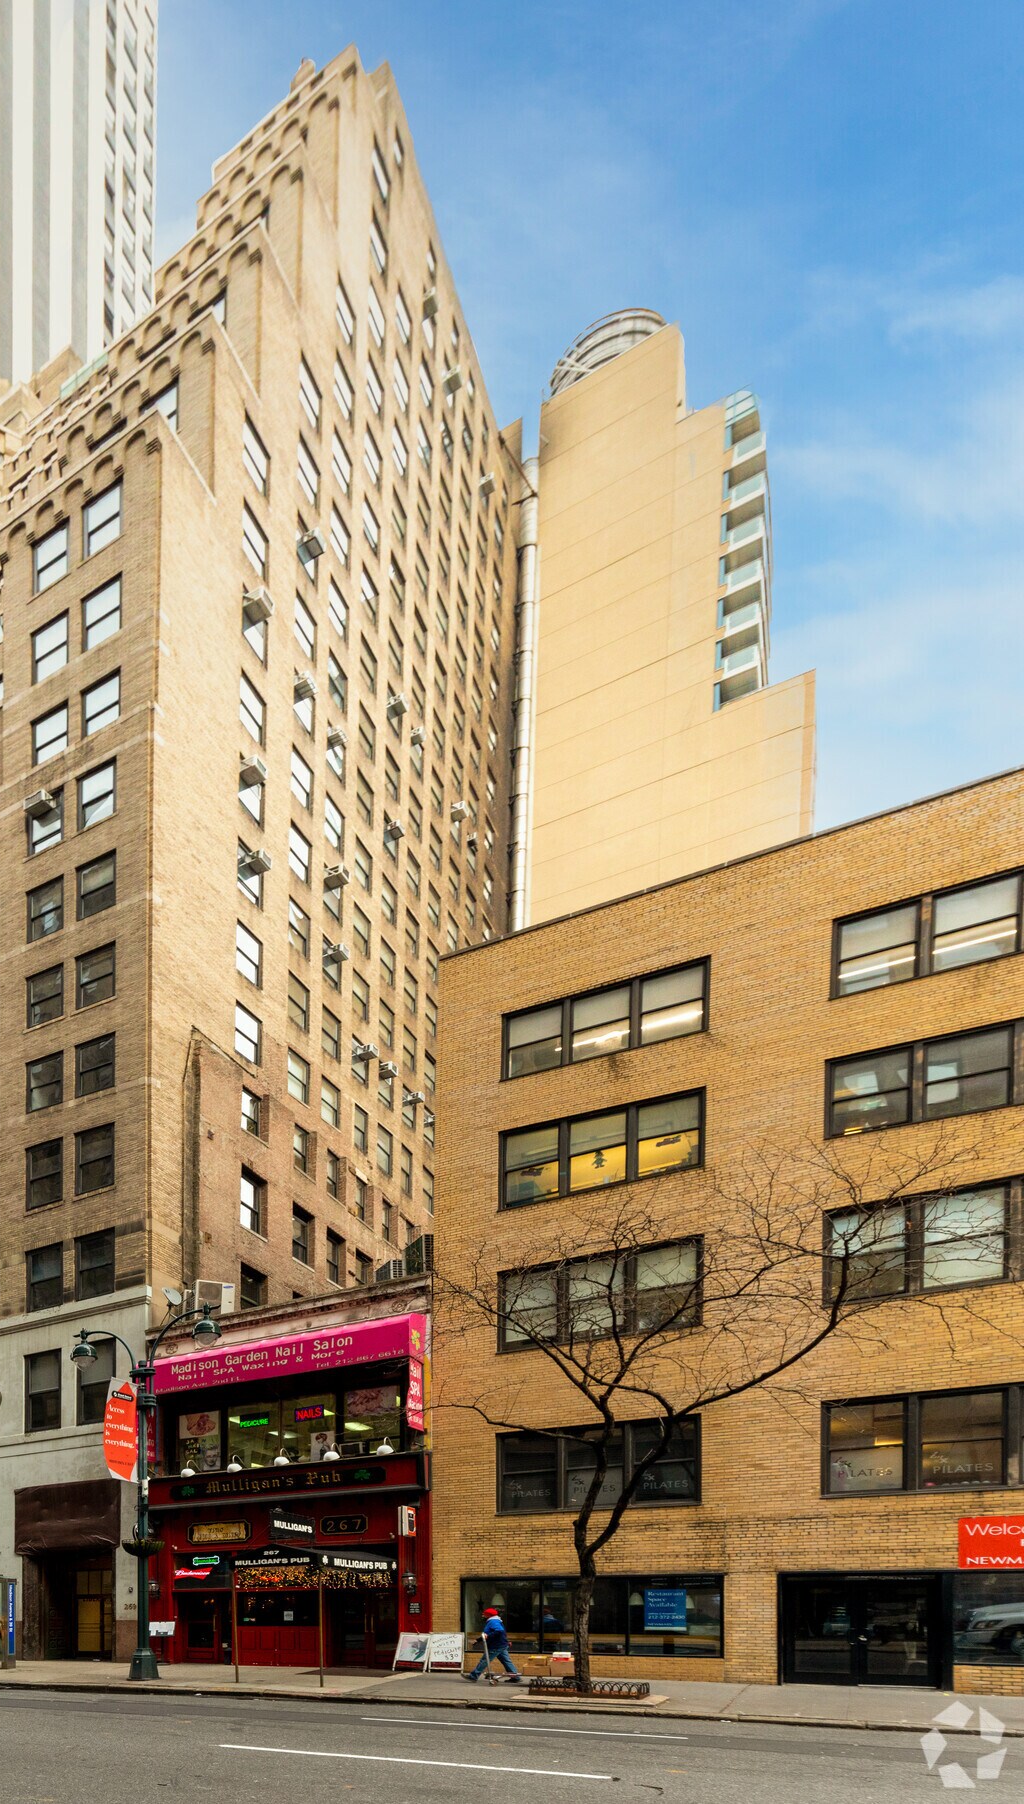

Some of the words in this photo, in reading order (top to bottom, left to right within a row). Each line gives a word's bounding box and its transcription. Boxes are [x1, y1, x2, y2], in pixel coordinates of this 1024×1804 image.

[171, 1359, 218, 1375] Madison
[225, 1350, 268, 1366] Garden
[275, 1343, 304, 1357] Nail
[313, 1336, 353, 1351] Salon
[177, 1371, 204, 1381] Nail
[213, 1367, 235, 1376] SPA
[241, 1359, 288, 1371] Waxing
[311, 1349, 344, 1360] More
[108, 1404, 125, 1414] Access
[297, 1408, 322, 1420] NAILS
[105, 1422, 134, 1433] everything
[240, 1418, 269, 1428] PEDICURE
[104, 1438, 135, 1449] everything.
[933, 1462, 994, 1474] PILATES
[205, 1476, 294, 1494] Mulligan's
[305, 1470, 342, 1485] Pub
[643, 1479, 689, 1490] PILATES
[511, 1489, 551, 1498] PILATES
[573, 1484, 616, 1494] PILES
[274, 1519, 313, 1534] MULLIGAN'S
[326, 1519, 362, 1532] 267
[234, 1558, 288, 1566] MULLIGAN'S
[334, 1558, 374, 1569] MULLIGAN'S
[374, 1562, 388, 1570] PUB
[966, 1556, 1024, 1565] NEWM
